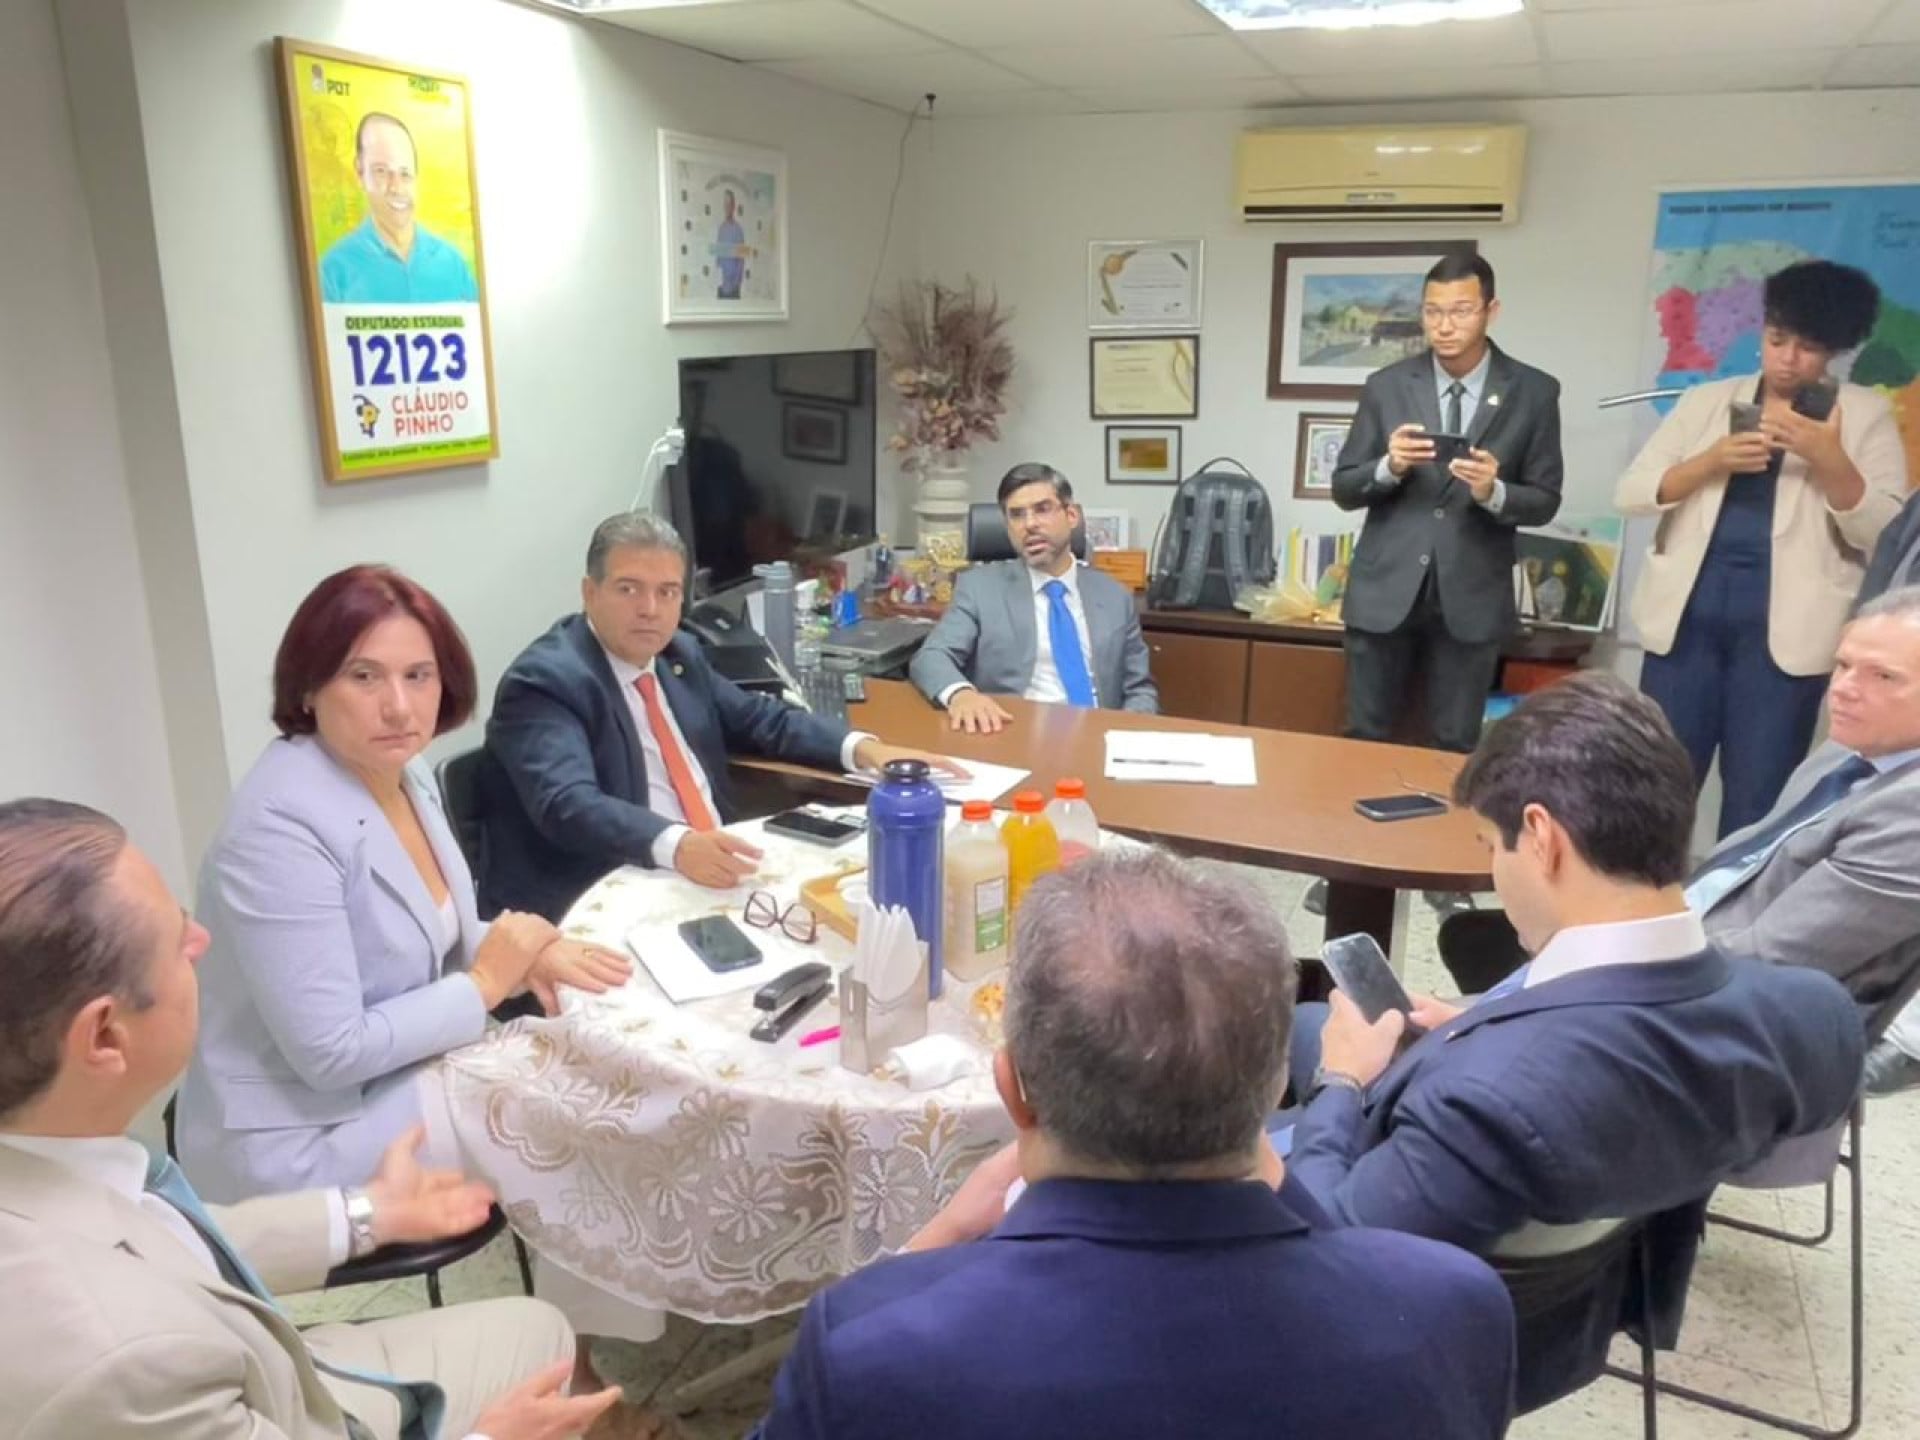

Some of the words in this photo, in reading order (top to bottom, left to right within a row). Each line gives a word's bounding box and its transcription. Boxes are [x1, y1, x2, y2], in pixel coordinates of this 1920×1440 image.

[345, 316, 409, 330] DEPUTADO
[413, 315, 465, 328] ESTADUAL
[347, 333, 468, 386] 12123
[392, 387, 469, 415] CLÁUDIO
[394, 414, 454, 437] PINHO
